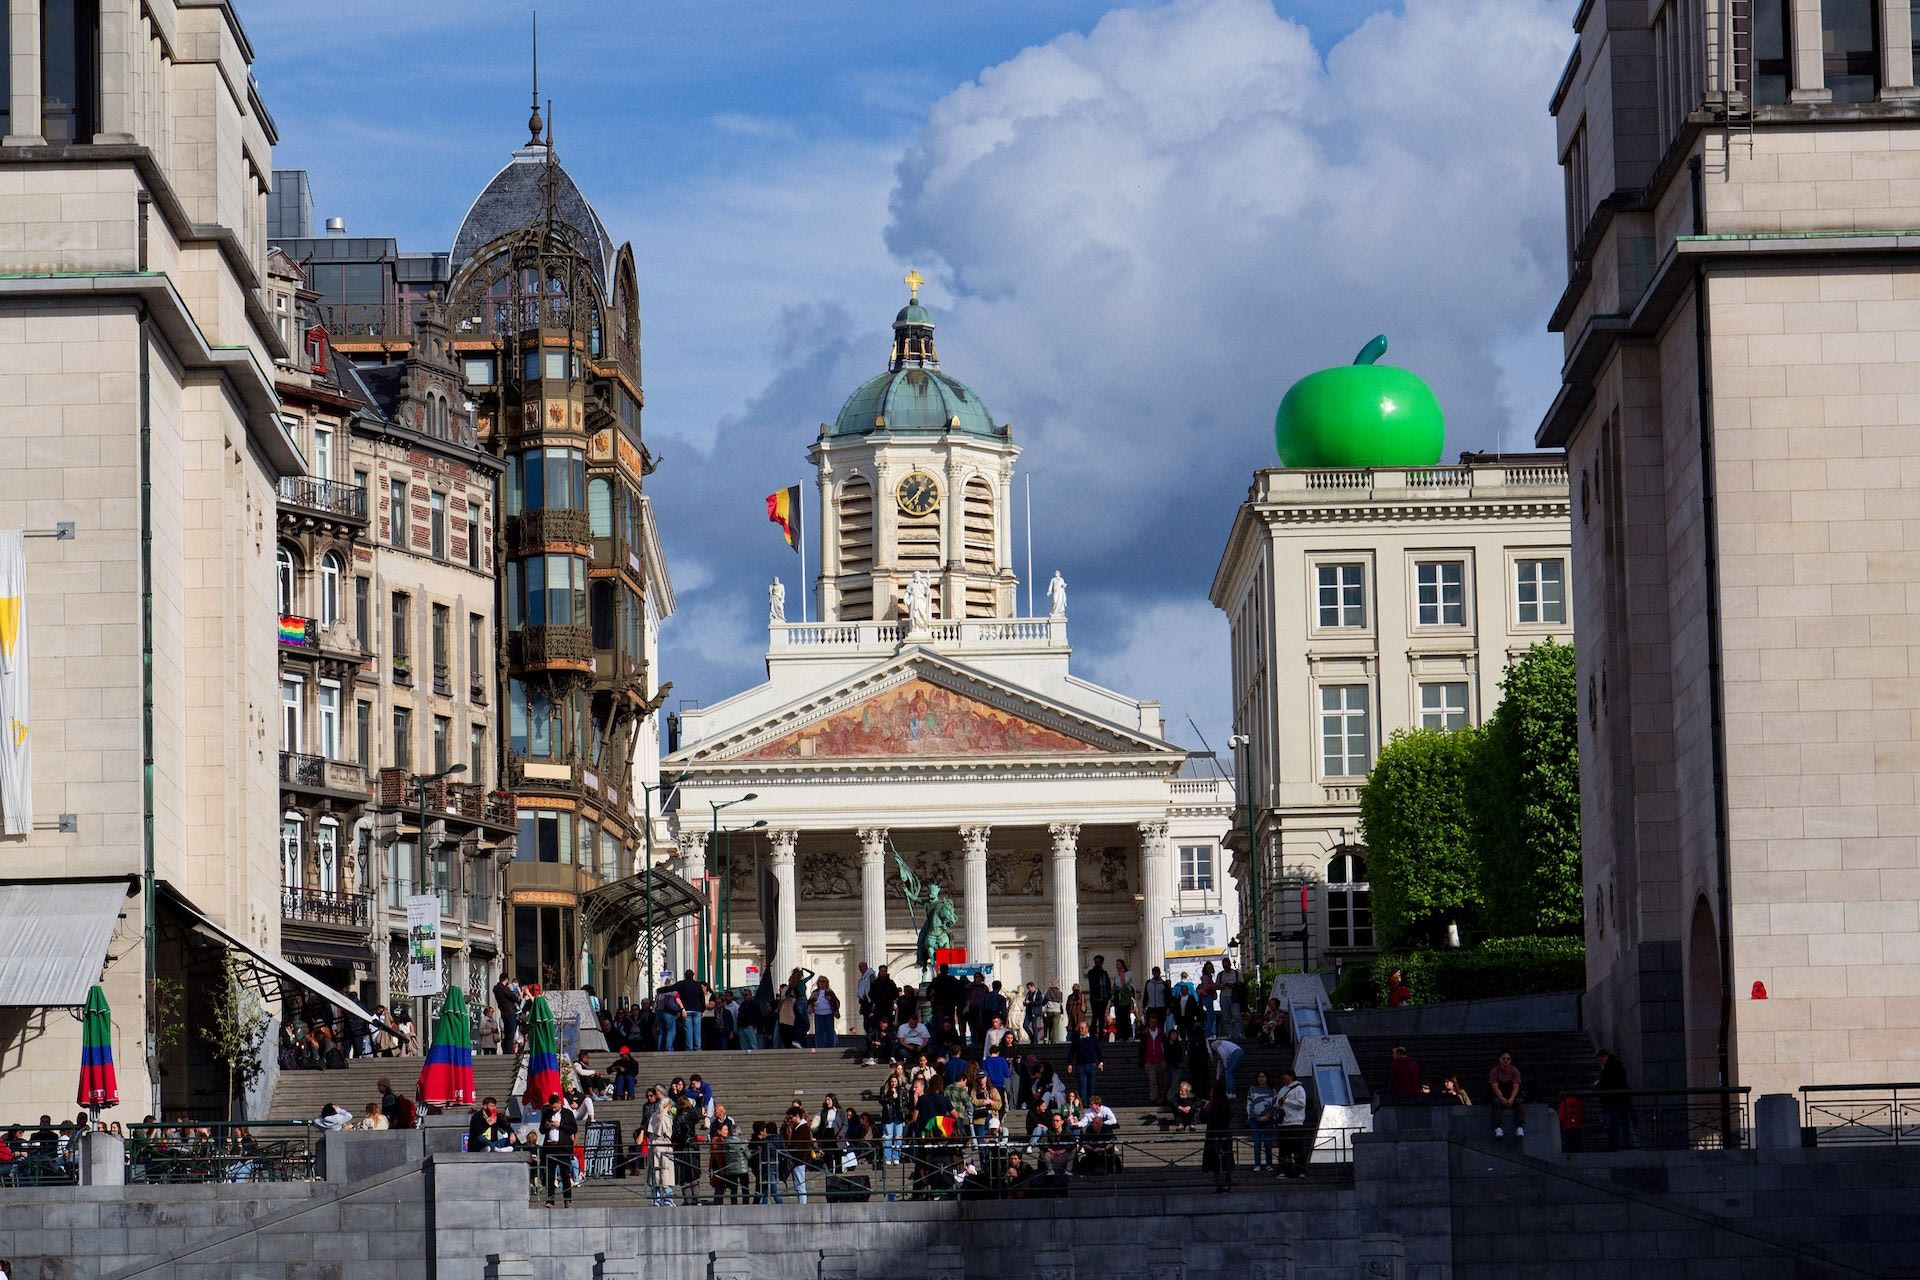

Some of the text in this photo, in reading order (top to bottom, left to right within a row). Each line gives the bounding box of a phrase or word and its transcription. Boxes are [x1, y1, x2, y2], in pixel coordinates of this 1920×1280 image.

[410, 931, 435, 940] brussels
[304, 957, 333, 966] MUSIQUE
[584, 1157, 614, 1176] PEOPLE
